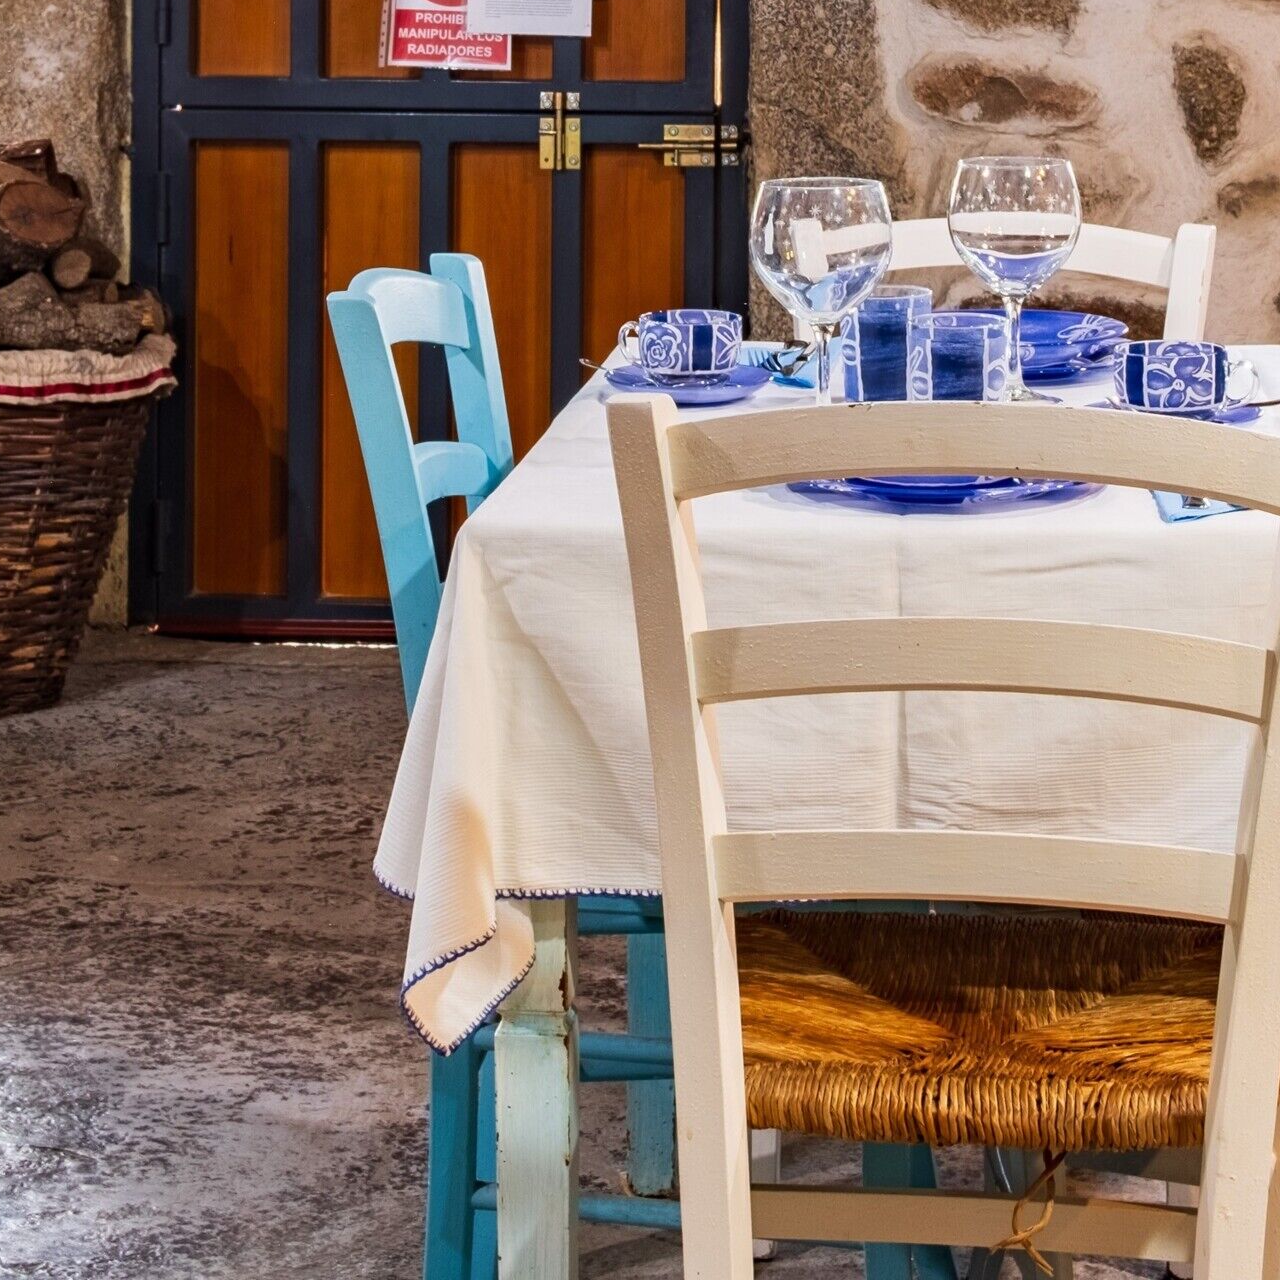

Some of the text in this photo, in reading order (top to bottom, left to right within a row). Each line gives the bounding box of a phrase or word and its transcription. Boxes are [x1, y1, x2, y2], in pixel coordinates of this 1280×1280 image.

[415, 12, 465, 25] PROHIB
[398, 27, 474, 41] MANIPULAR
[407, 43, 493, 57] RADIADORES
